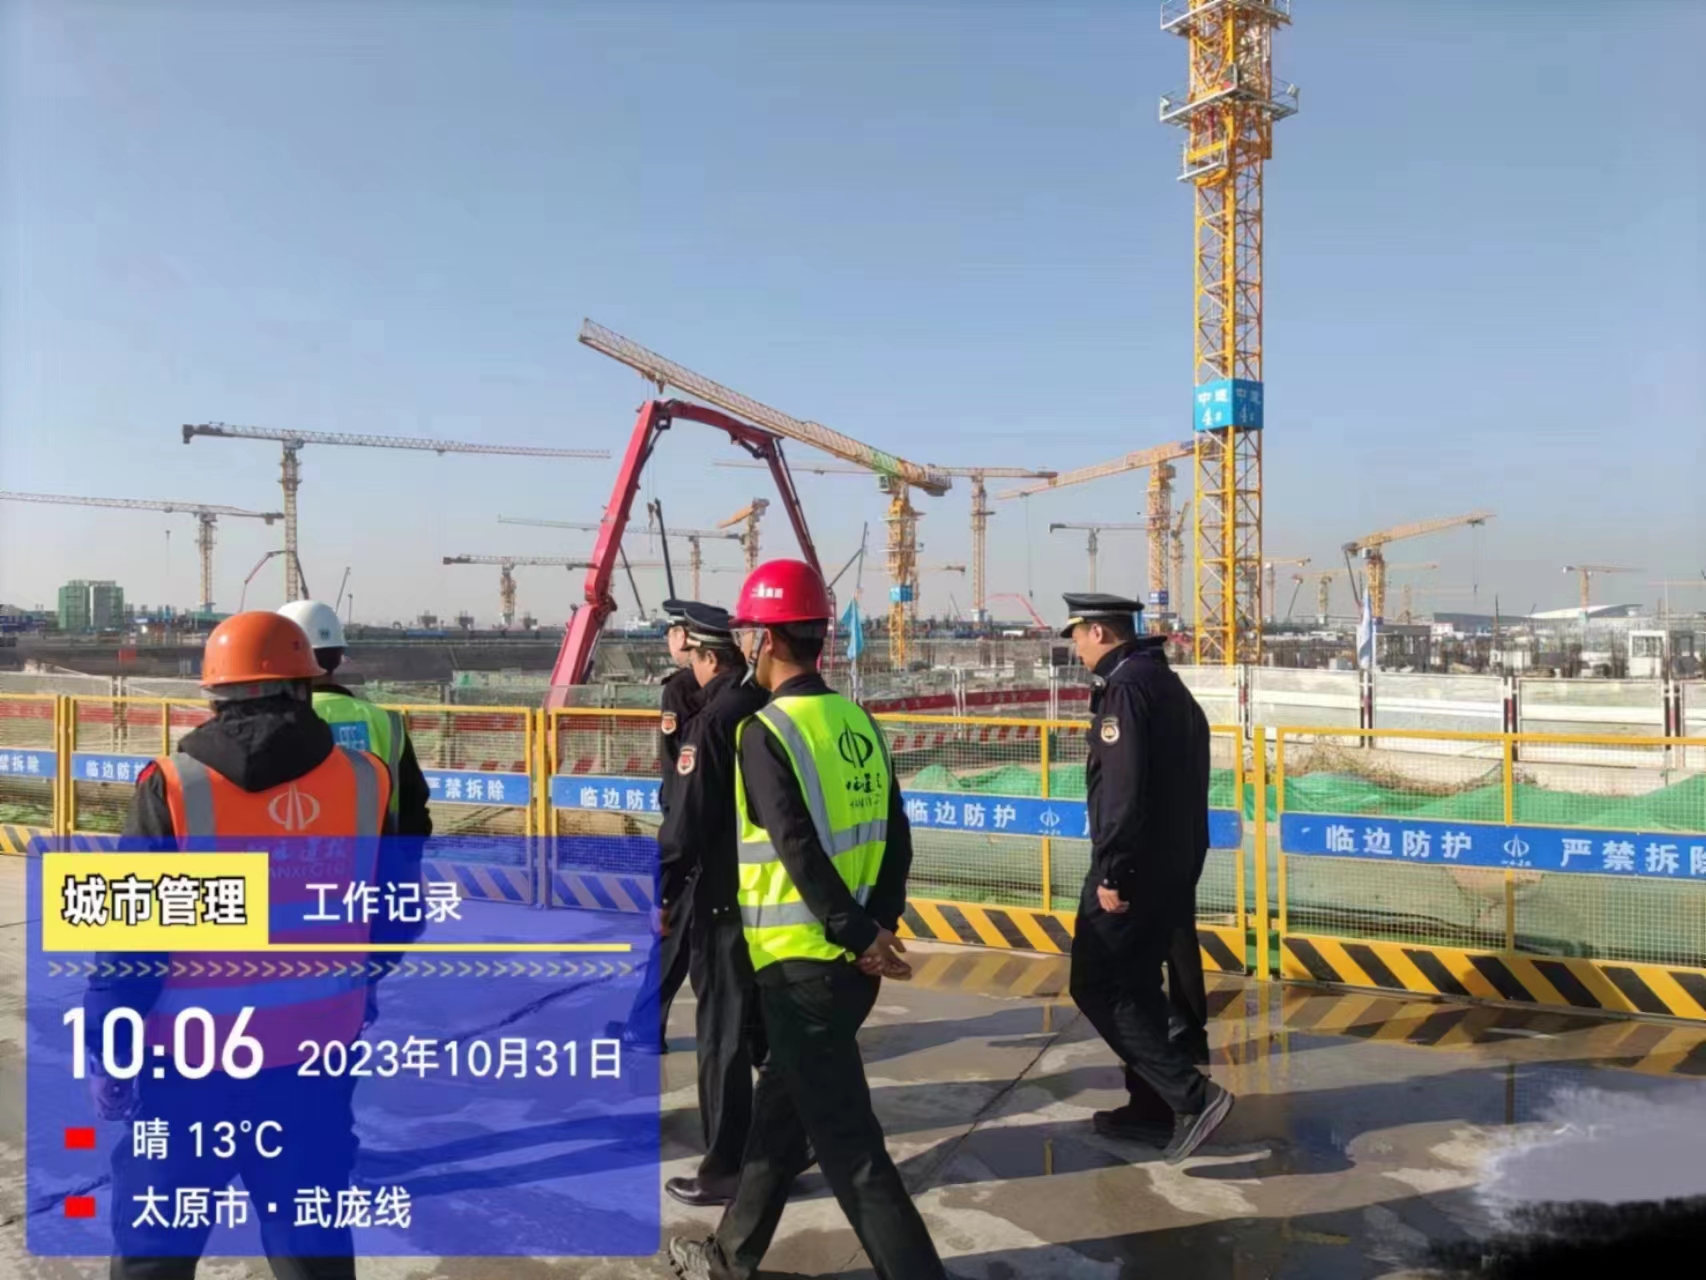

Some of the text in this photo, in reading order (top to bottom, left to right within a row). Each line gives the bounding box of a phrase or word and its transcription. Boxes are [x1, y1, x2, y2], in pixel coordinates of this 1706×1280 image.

[906, 799, 1017, 828] 临边防护
[1325, 824, 1473, 859] 临边防护
